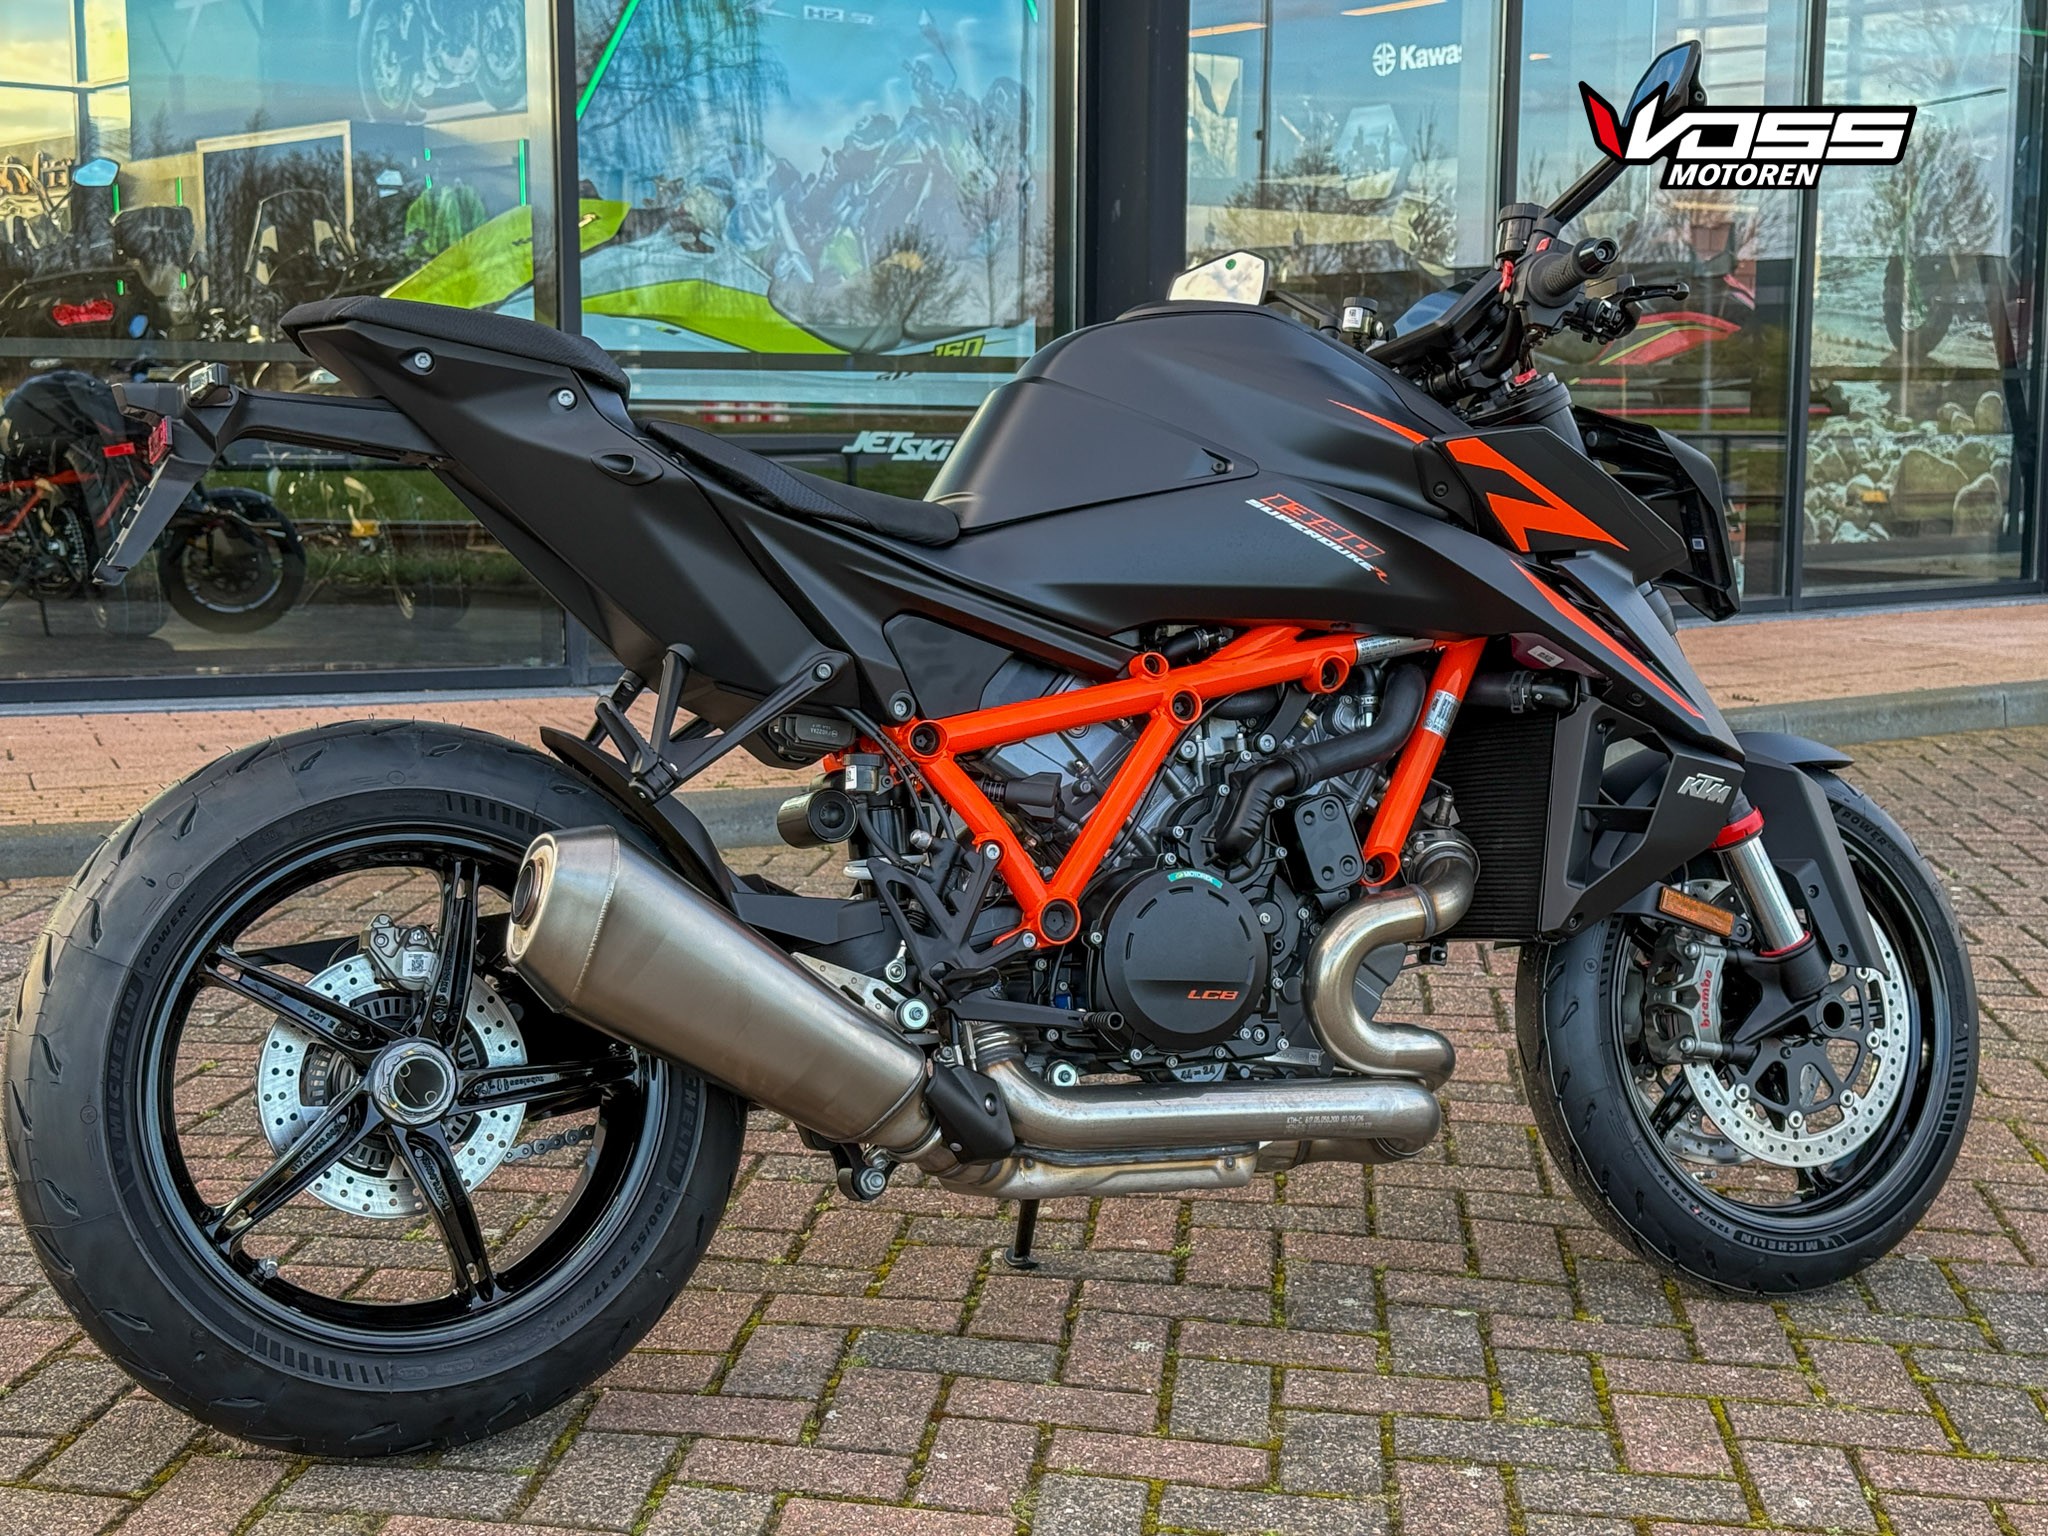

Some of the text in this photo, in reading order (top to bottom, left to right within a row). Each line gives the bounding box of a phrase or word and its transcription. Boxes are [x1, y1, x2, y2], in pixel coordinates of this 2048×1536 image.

[1677, 772, 1732, 805] KTM
[1841, 810, 1888, 847] POWER
[1183, 870, 1214, 882] MOTOREX
[143, 905, 188, 969] POWER
[1700, 969, 1713, 1029] brembo
[108, 989, 139, 1144] MICHELIN
[1658, 1174, 1671, 1188] 17
[1671, 1188, 1688, 1204] ZR
[630, 1190, 670, 1255] 200/55
[1740, 1233, 1818, 1251] MICHELIN
[610, 1255, 630, 1280] ZR
[593, 1280, 609, 1300] 17
